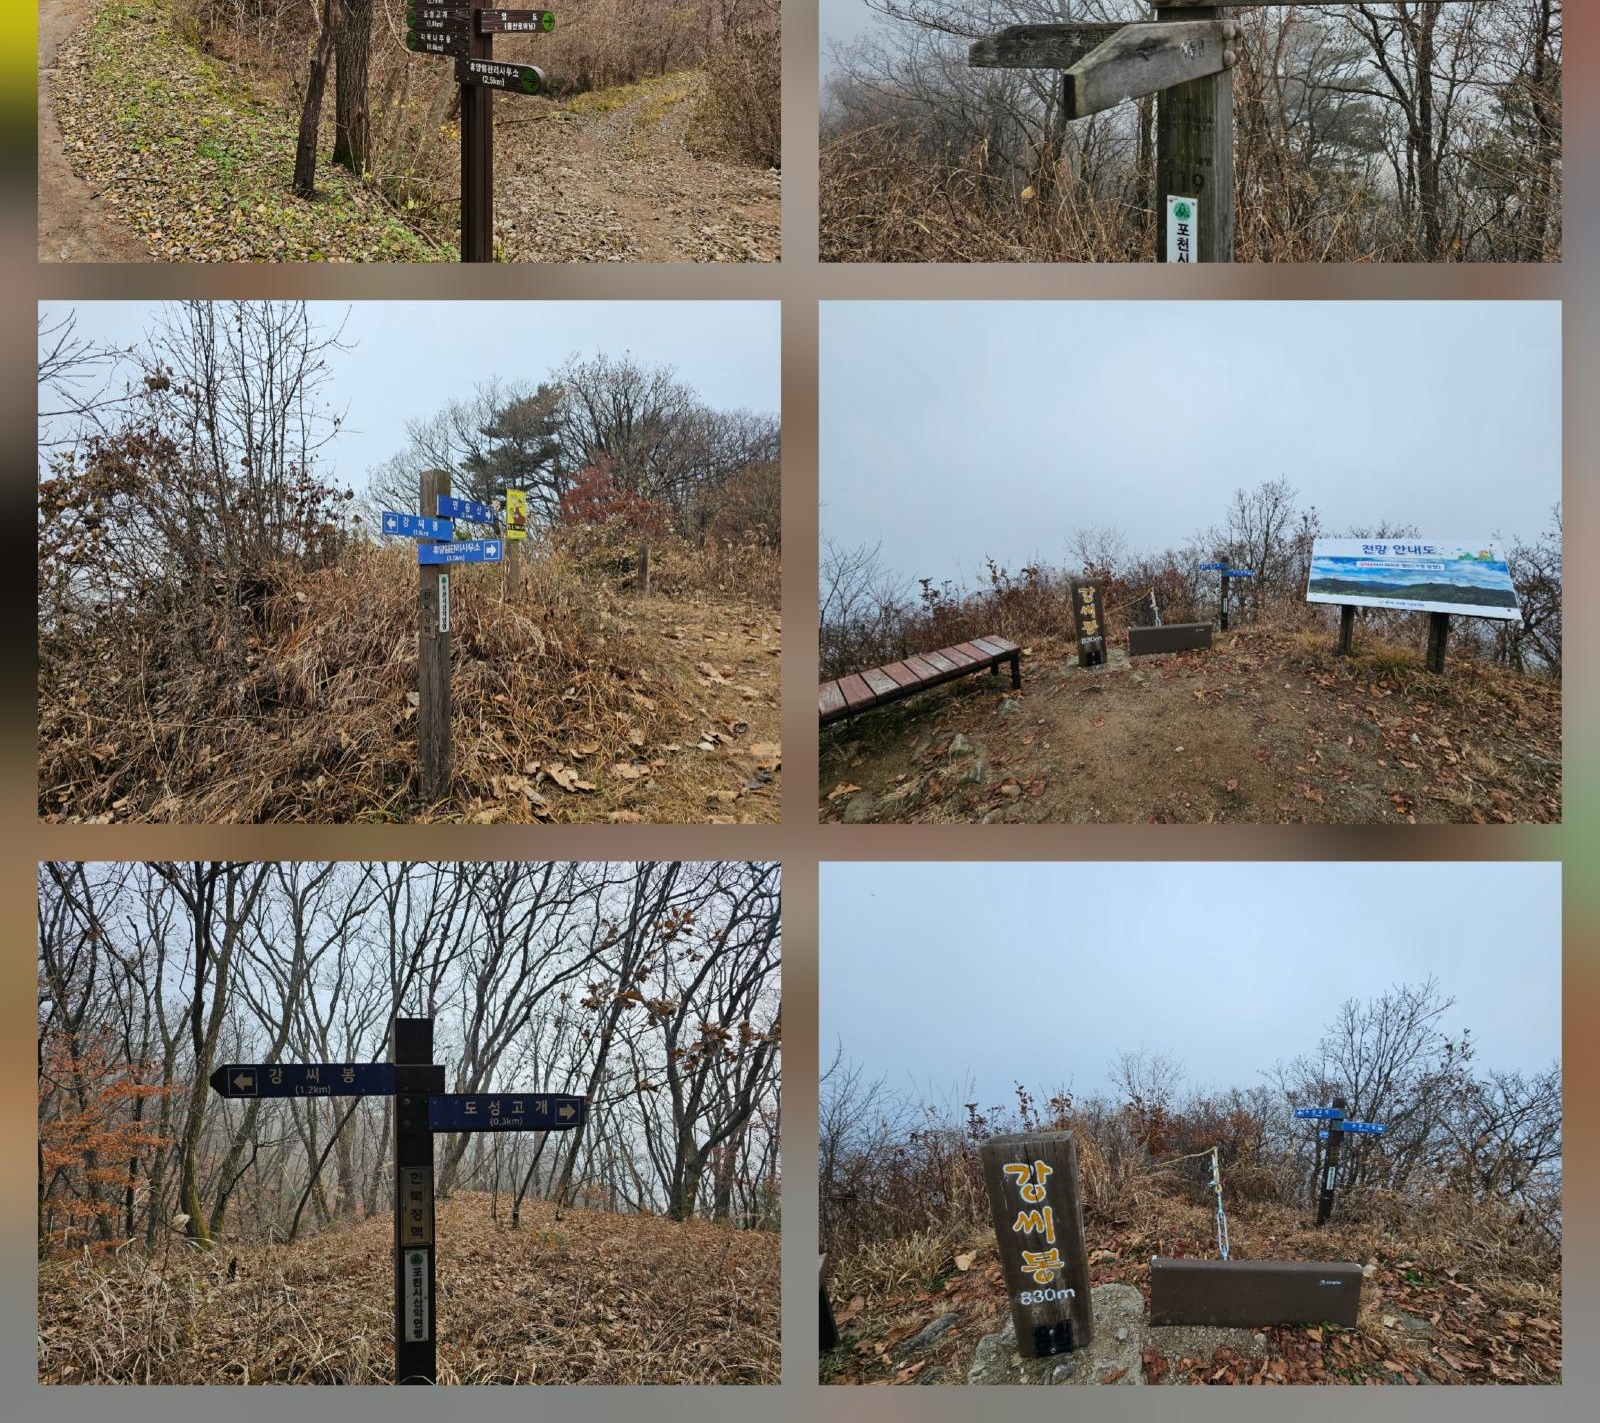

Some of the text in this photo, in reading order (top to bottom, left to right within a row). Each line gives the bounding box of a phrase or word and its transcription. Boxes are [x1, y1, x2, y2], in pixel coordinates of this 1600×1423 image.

[1362, 544, 1436, 555] 전망 안내도
[268, 1066, 356, 1084] 강씨봉
[464, 1099, 548, 1116] 도성고개
[1002, 1160, 1065, 1284] 강씨봉
[1020, 1288, 1076, 1306] 830m
